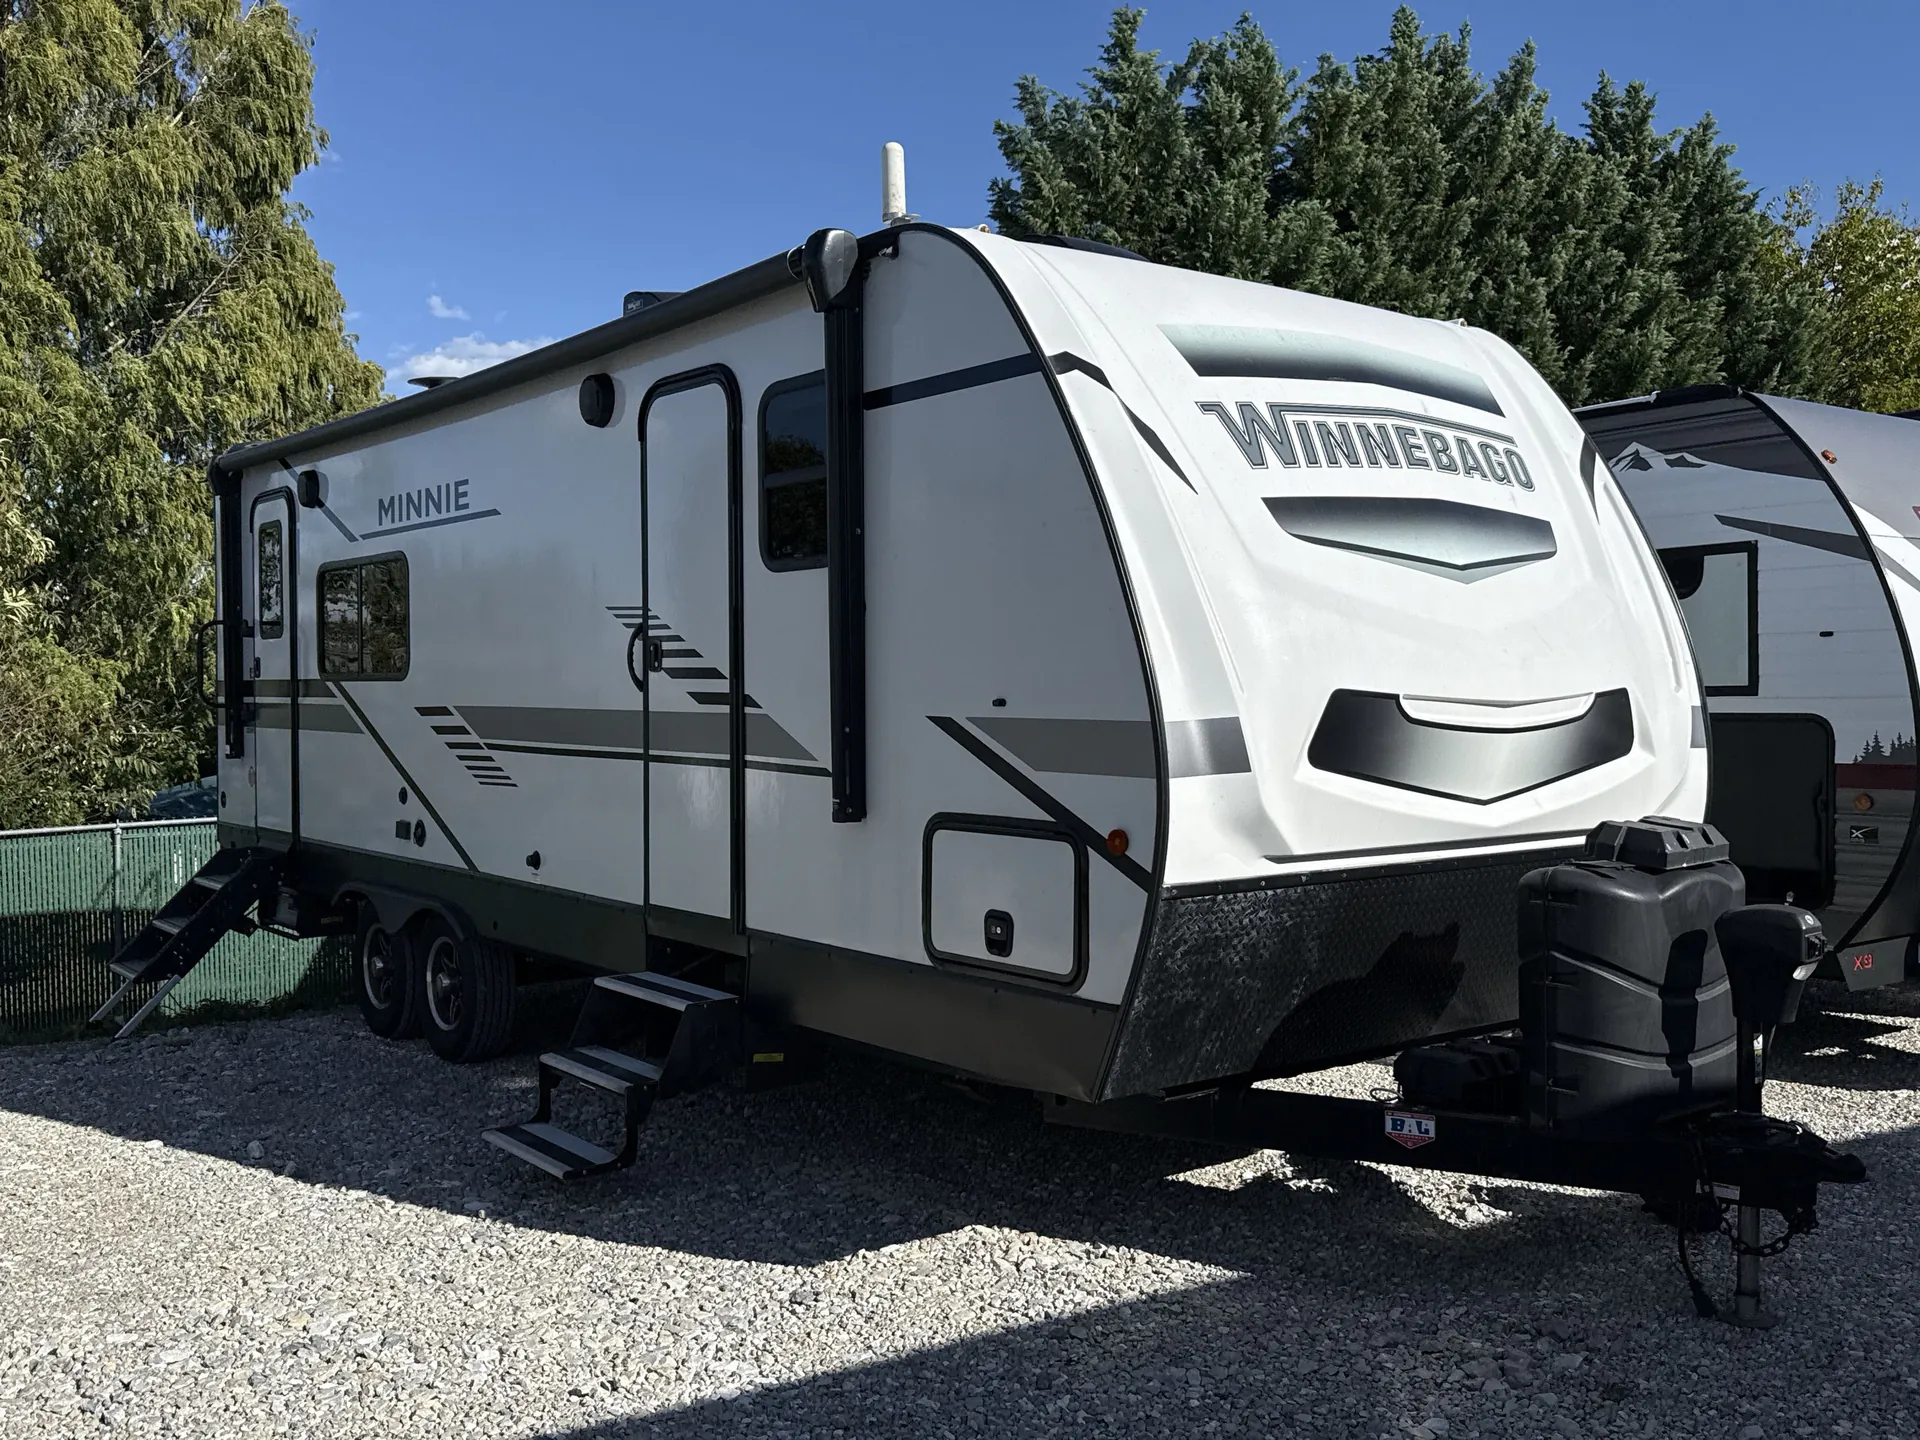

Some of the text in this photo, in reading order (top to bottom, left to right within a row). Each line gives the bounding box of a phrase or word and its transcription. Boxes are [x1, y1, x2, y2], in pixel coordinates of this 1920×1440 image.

[1195, 401, 1536, 492] WINNEBAGO
[378, 479, 470, 526] MINNIE
[1390, 1117, 1430, 1135] BAL
